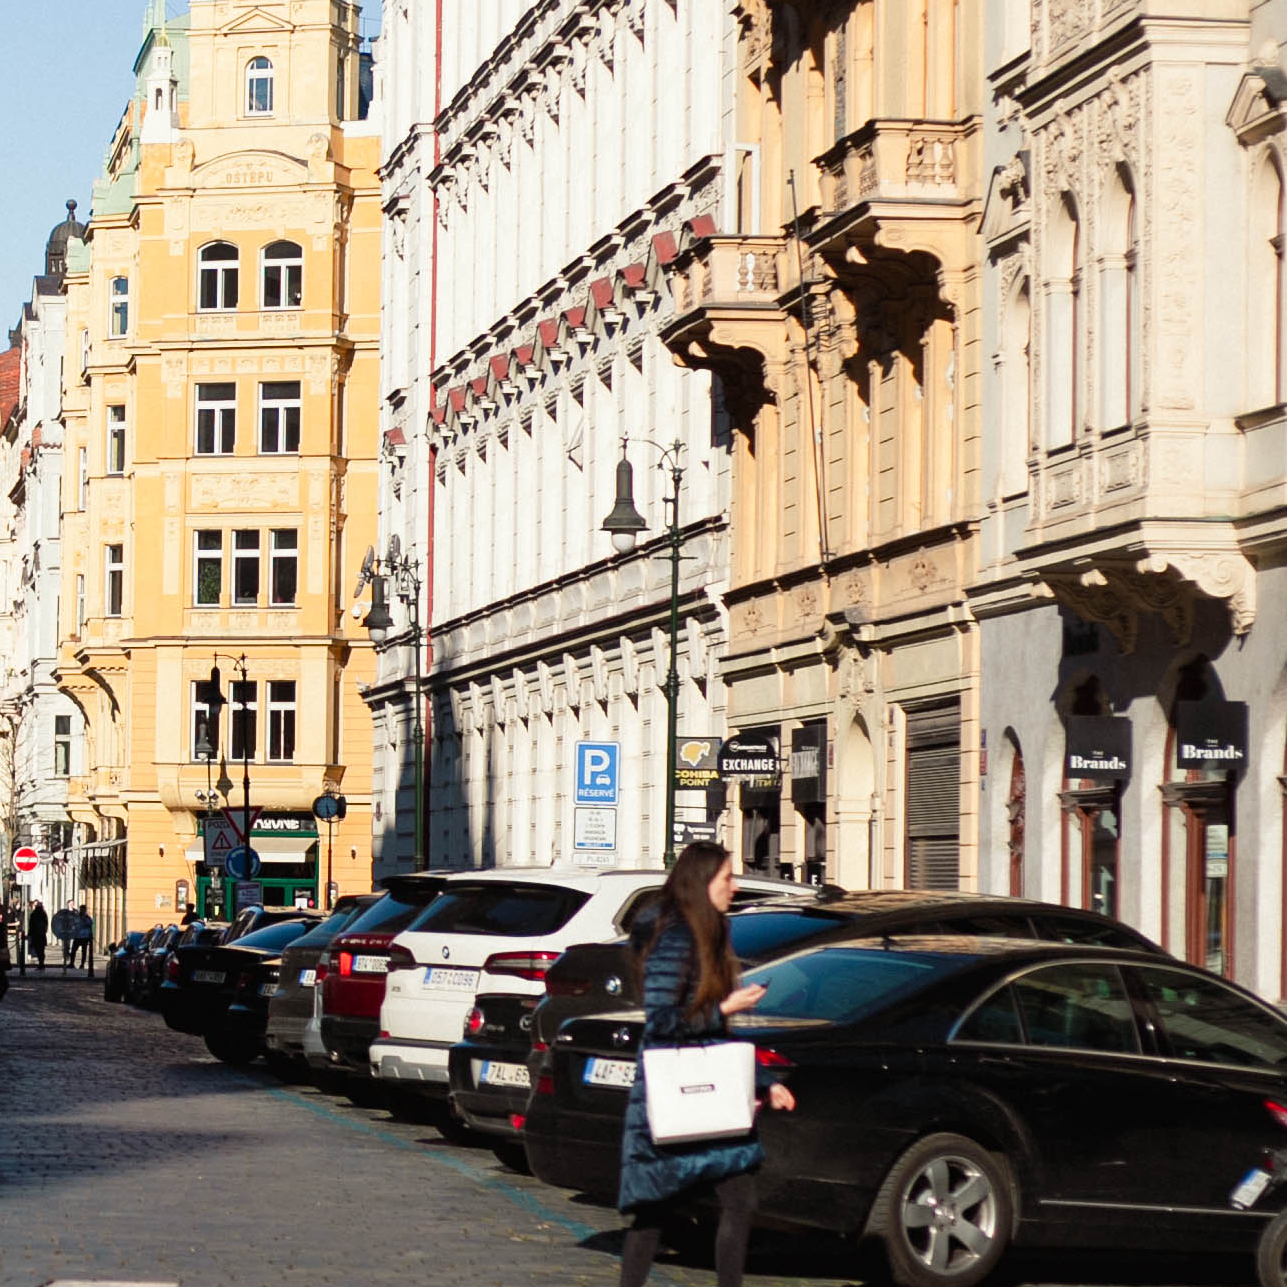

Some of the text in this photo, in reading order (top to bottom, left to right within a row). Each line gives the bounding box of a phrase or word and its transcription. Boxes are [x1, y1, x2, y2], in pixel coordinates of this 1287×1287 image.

[1183, 744, 1244, 759] Brands
[584, 749, 610, 785] P
[722, 758, 774, 771] EXCHANGE
[1070, 755, 1127, 770] Brands
[578, 787, 614, 797] RÉSERVÉ
[490, 1064, 506, 1081] 7AL
